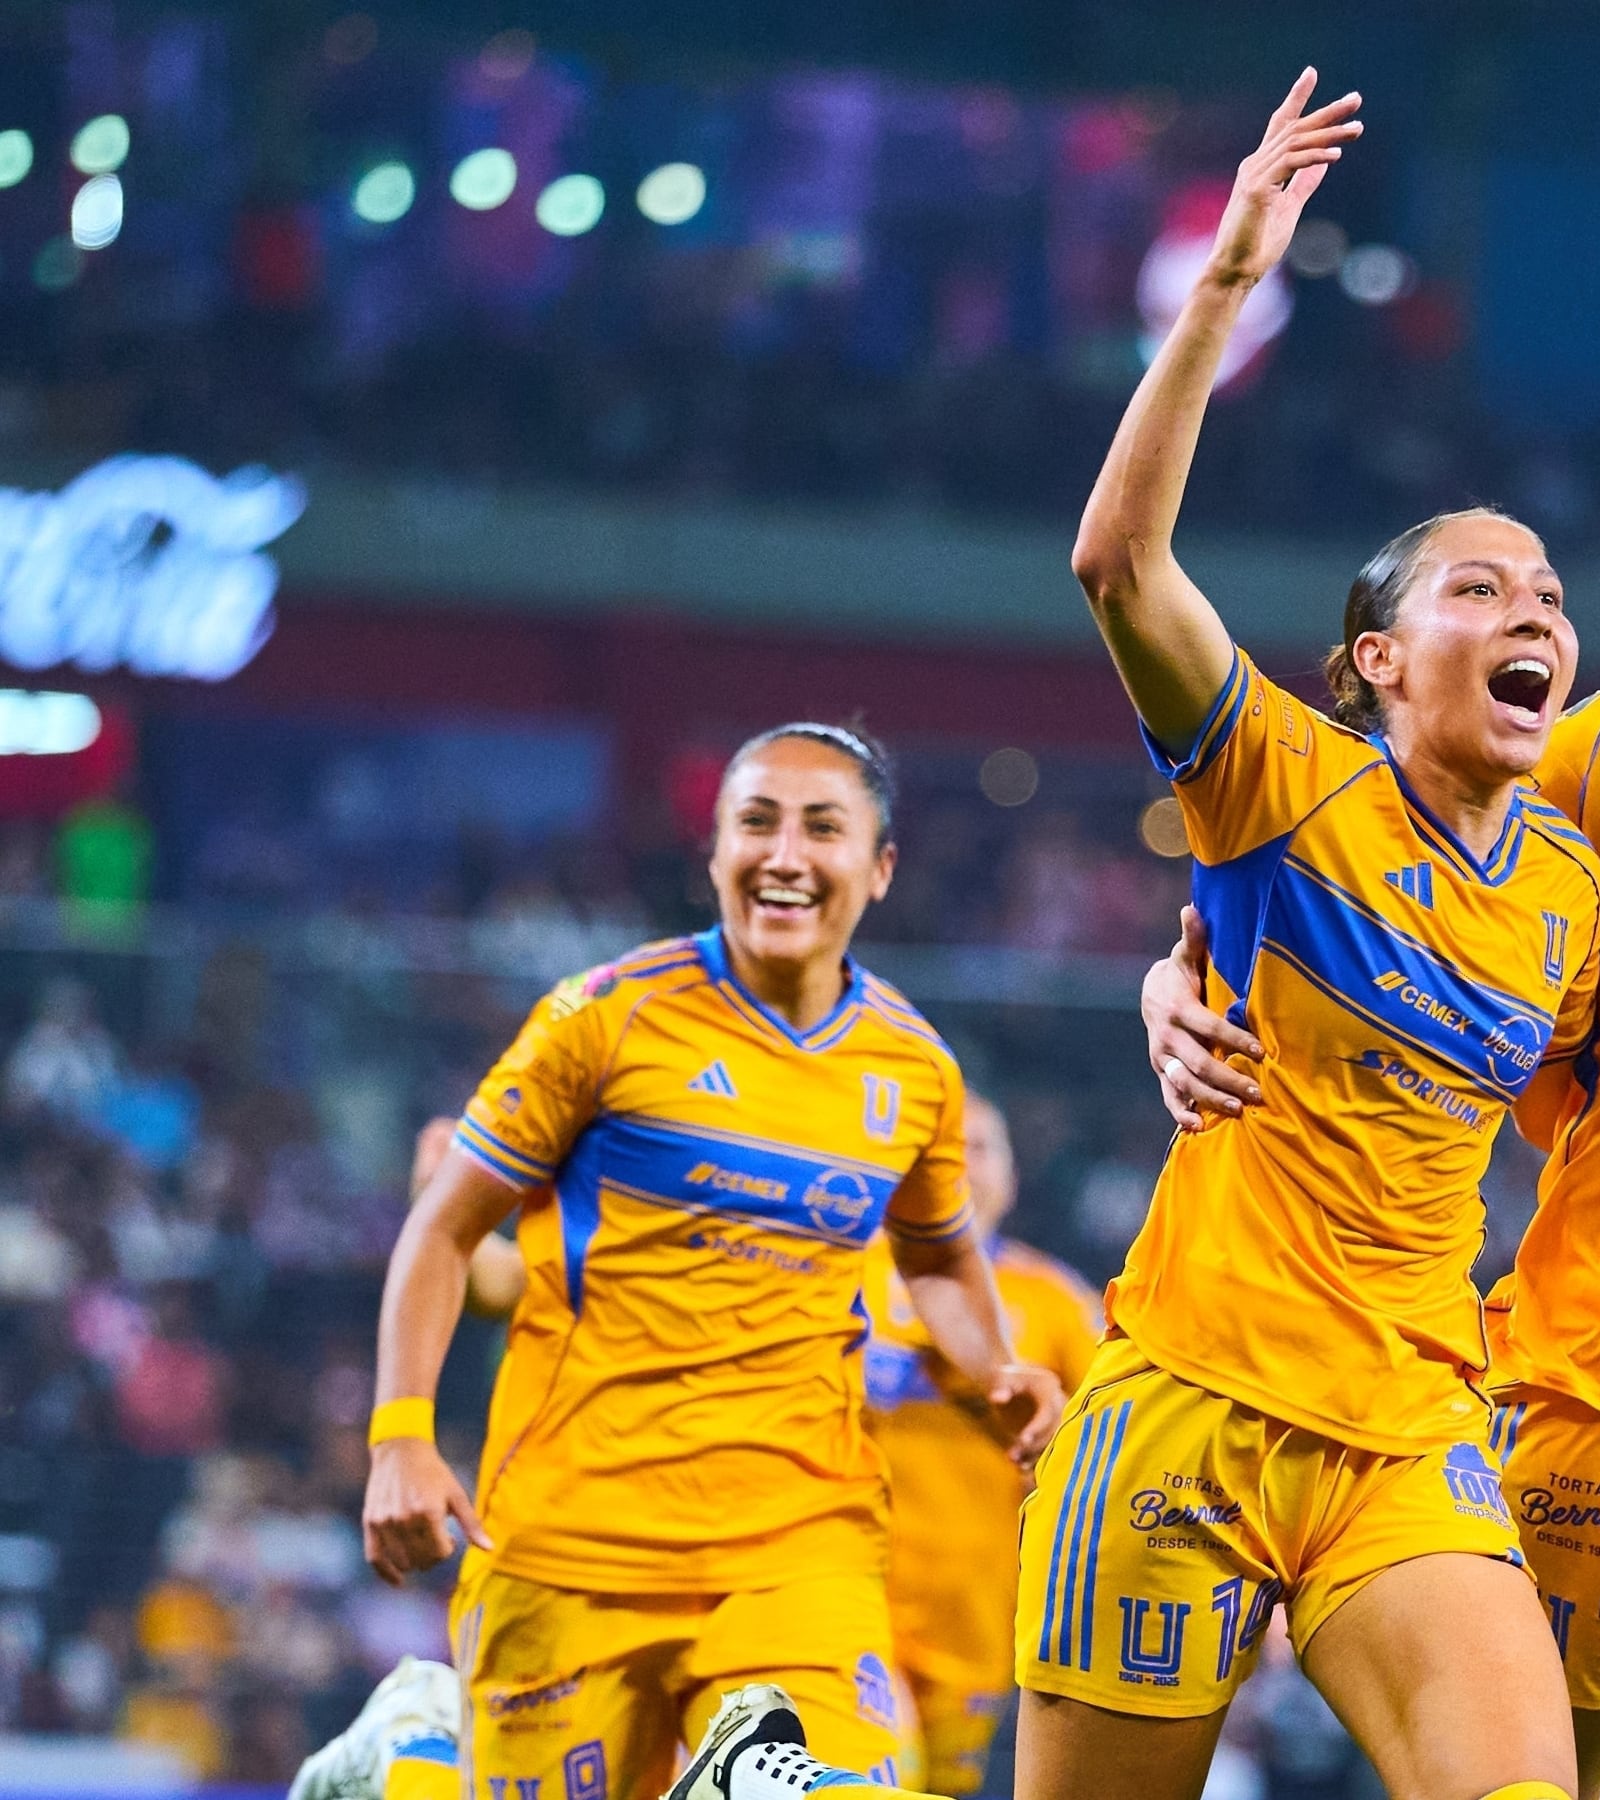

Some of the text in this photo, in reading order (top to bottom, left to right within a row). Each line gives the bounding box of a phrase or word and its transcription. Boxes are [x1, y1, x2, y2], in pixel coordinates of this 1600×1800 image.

[1541, 911, 1568, 981] U
[1400, 985, 1542, 1072] CEMEX Vertua
[1163, 1471, 1225, 1498] TORTAS
[1146, 1537, 1196, 1549] DESDE
[1537, 1532, 1584, 1553] DESDE
[1118, 1595, 1192, 1676] U
